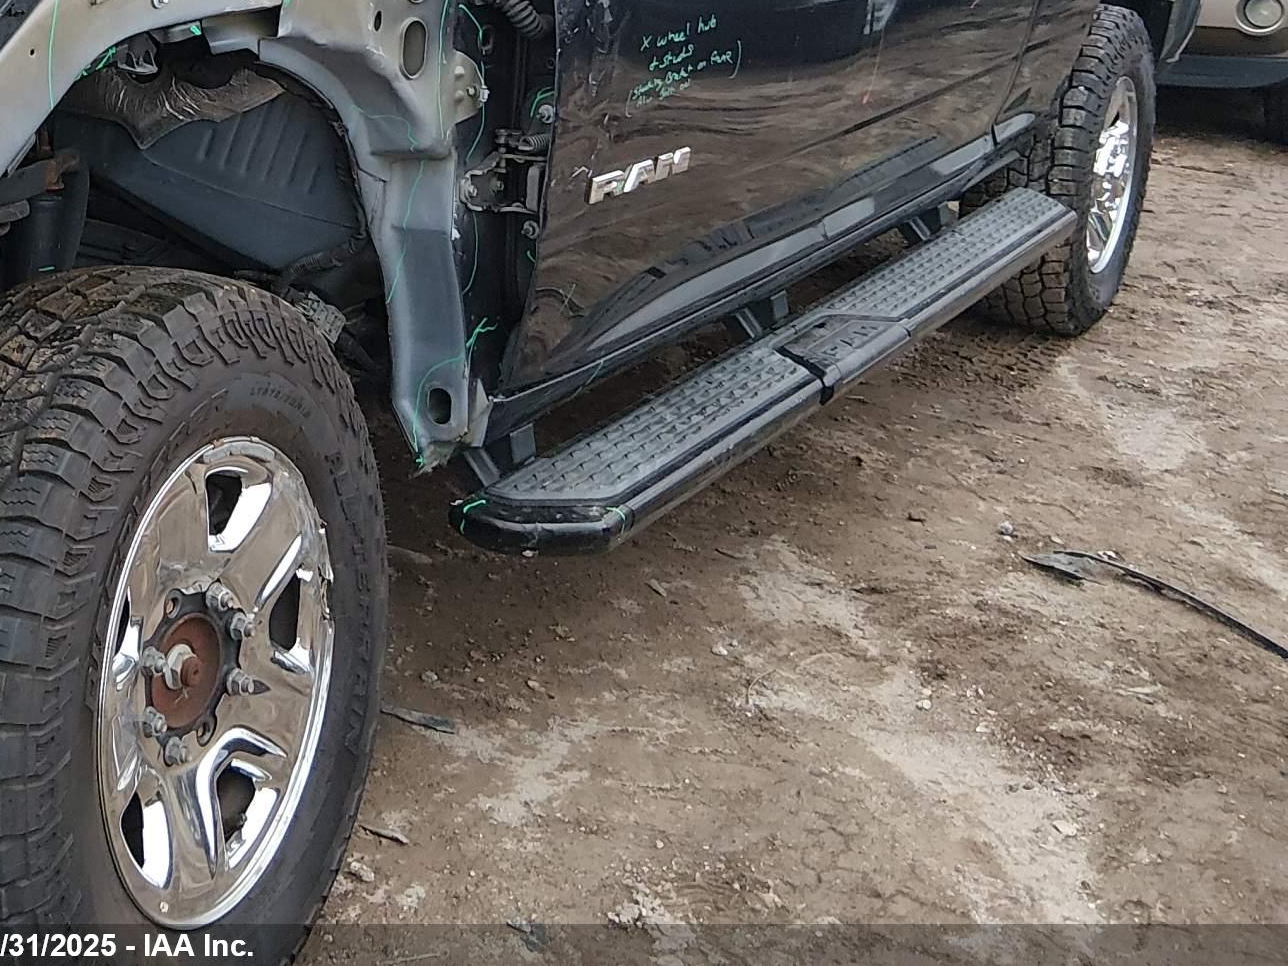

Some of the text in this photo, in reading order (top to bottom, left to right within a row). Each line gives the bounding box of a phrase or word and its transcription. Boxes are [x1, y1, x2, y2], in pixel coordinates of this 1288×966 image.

[656, 22, 690, 47] wheel
[697, 14, 717, 34] hub
[589, 146, 691, 205] RAM
